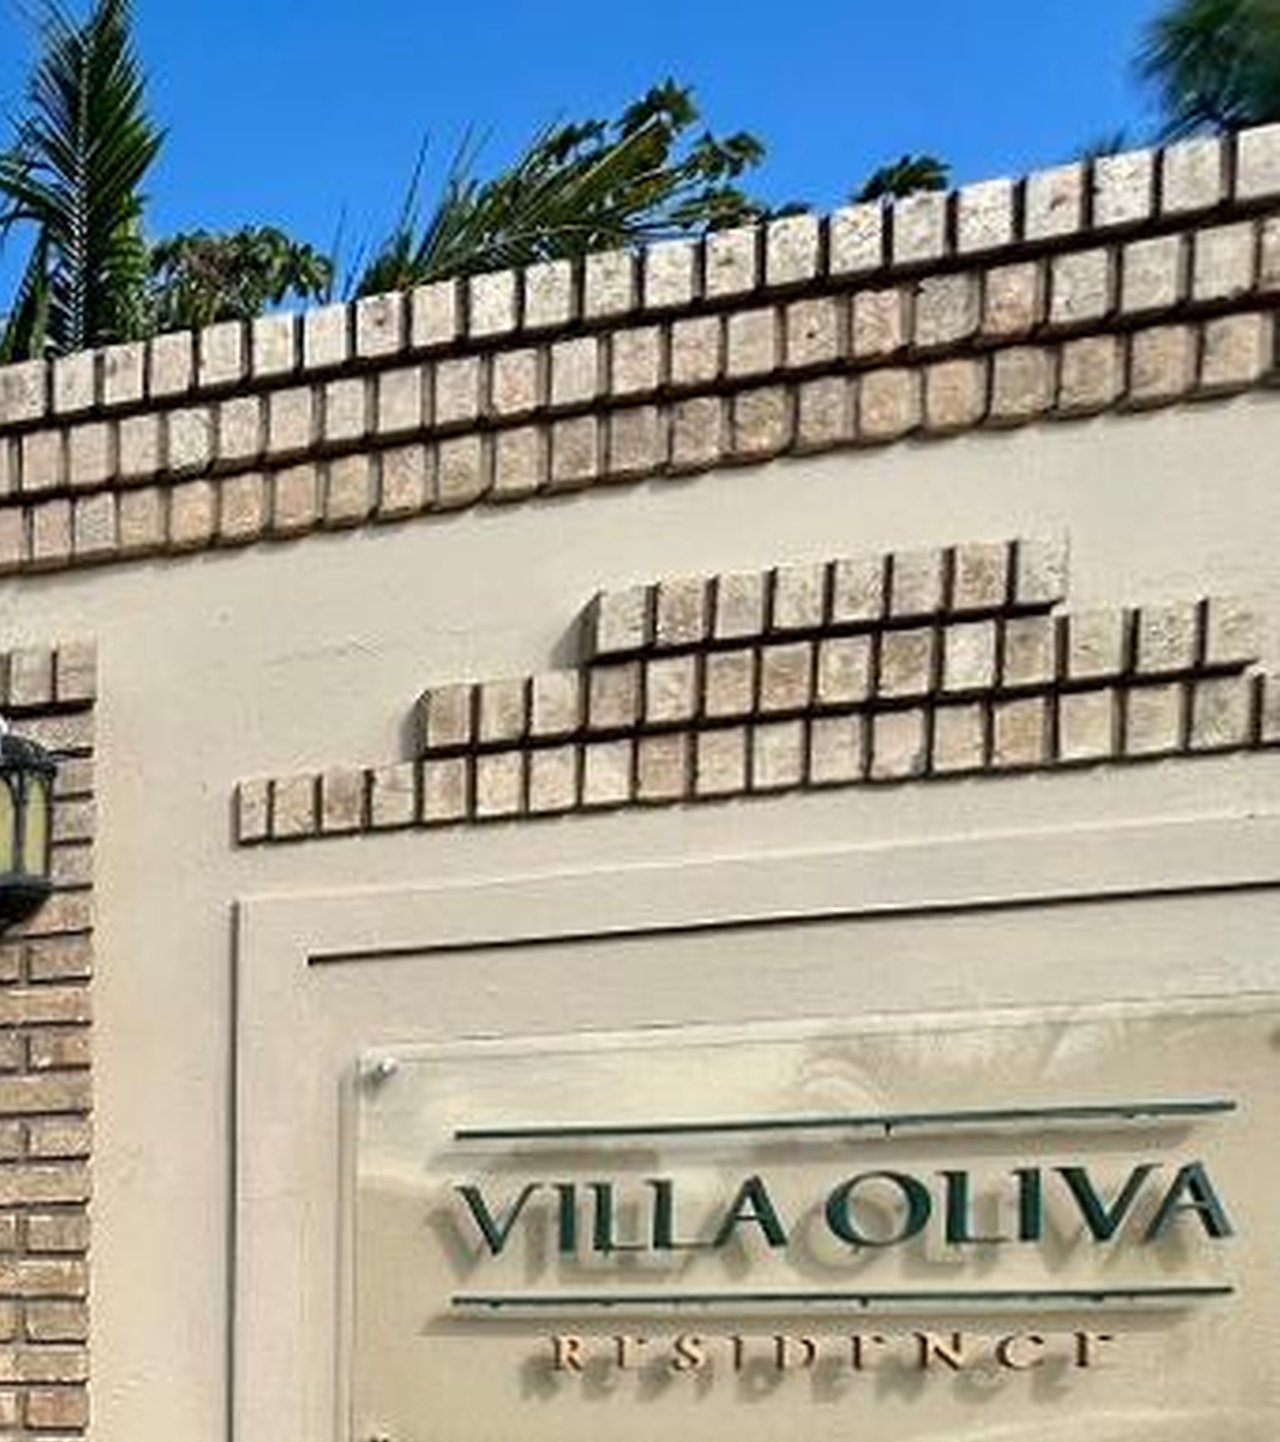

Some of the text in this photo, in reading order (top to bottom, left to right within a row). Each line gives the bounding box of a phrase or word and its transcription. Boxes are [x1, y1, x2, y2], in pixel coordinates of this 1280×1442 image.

[454, 1160, 1234, 1256] VILLA OLIVA
[552, 1332, 1114, 1372] RESIDENCE
